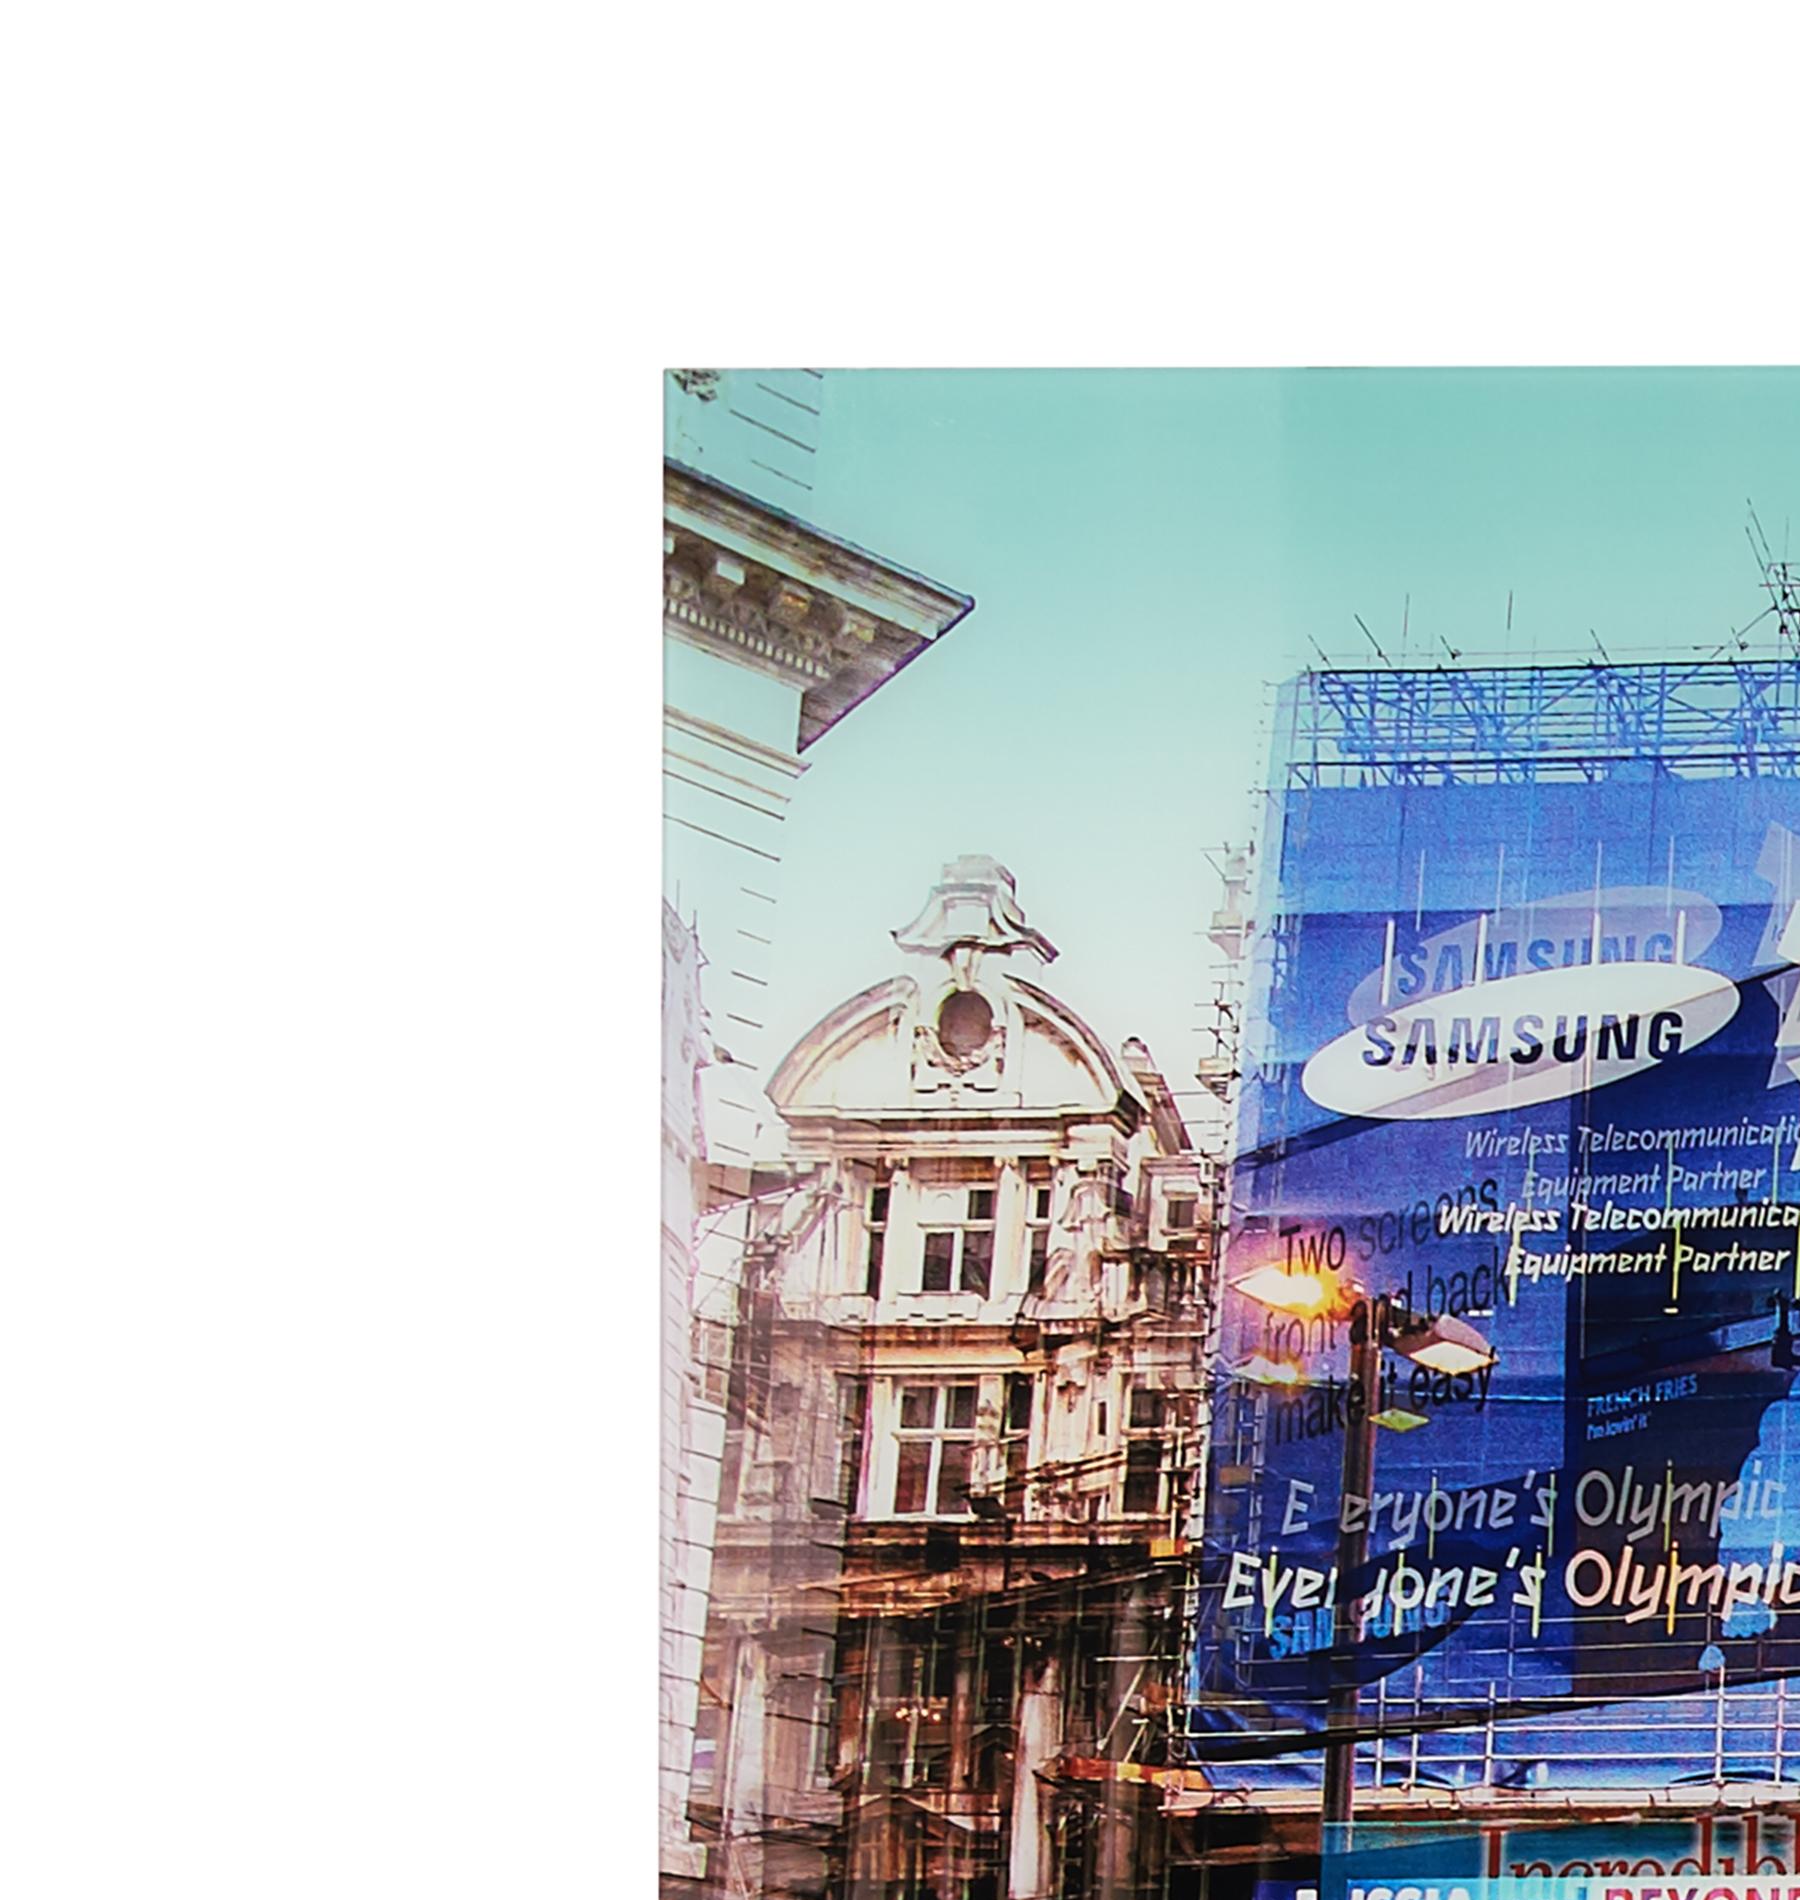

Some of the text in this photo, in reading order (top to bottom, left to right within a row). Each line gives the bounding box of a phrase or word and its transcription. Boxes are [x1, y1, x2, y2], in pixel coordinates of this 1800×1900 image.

[1361, 1011, 1685, 1068] SAMSUNG
[1464, 1125, 1569, 1160] Wireless
[1520, 1163, 1767, 1202] Equipment Partner
[1438, 1200, 1561, 1236] Wireless
[1279, 1222, 1348, 1278] Two
[1503, 1242, 1792, 1284] Equipment Partner
[1424, 1244, 1512, 1318] back
[1586, 1372, 1699, 1418] FRENCH FRIES
[1280, 1468, 1559, 1551] Eeryone's
[1575, 1459, 1788, 1543] Olympic
